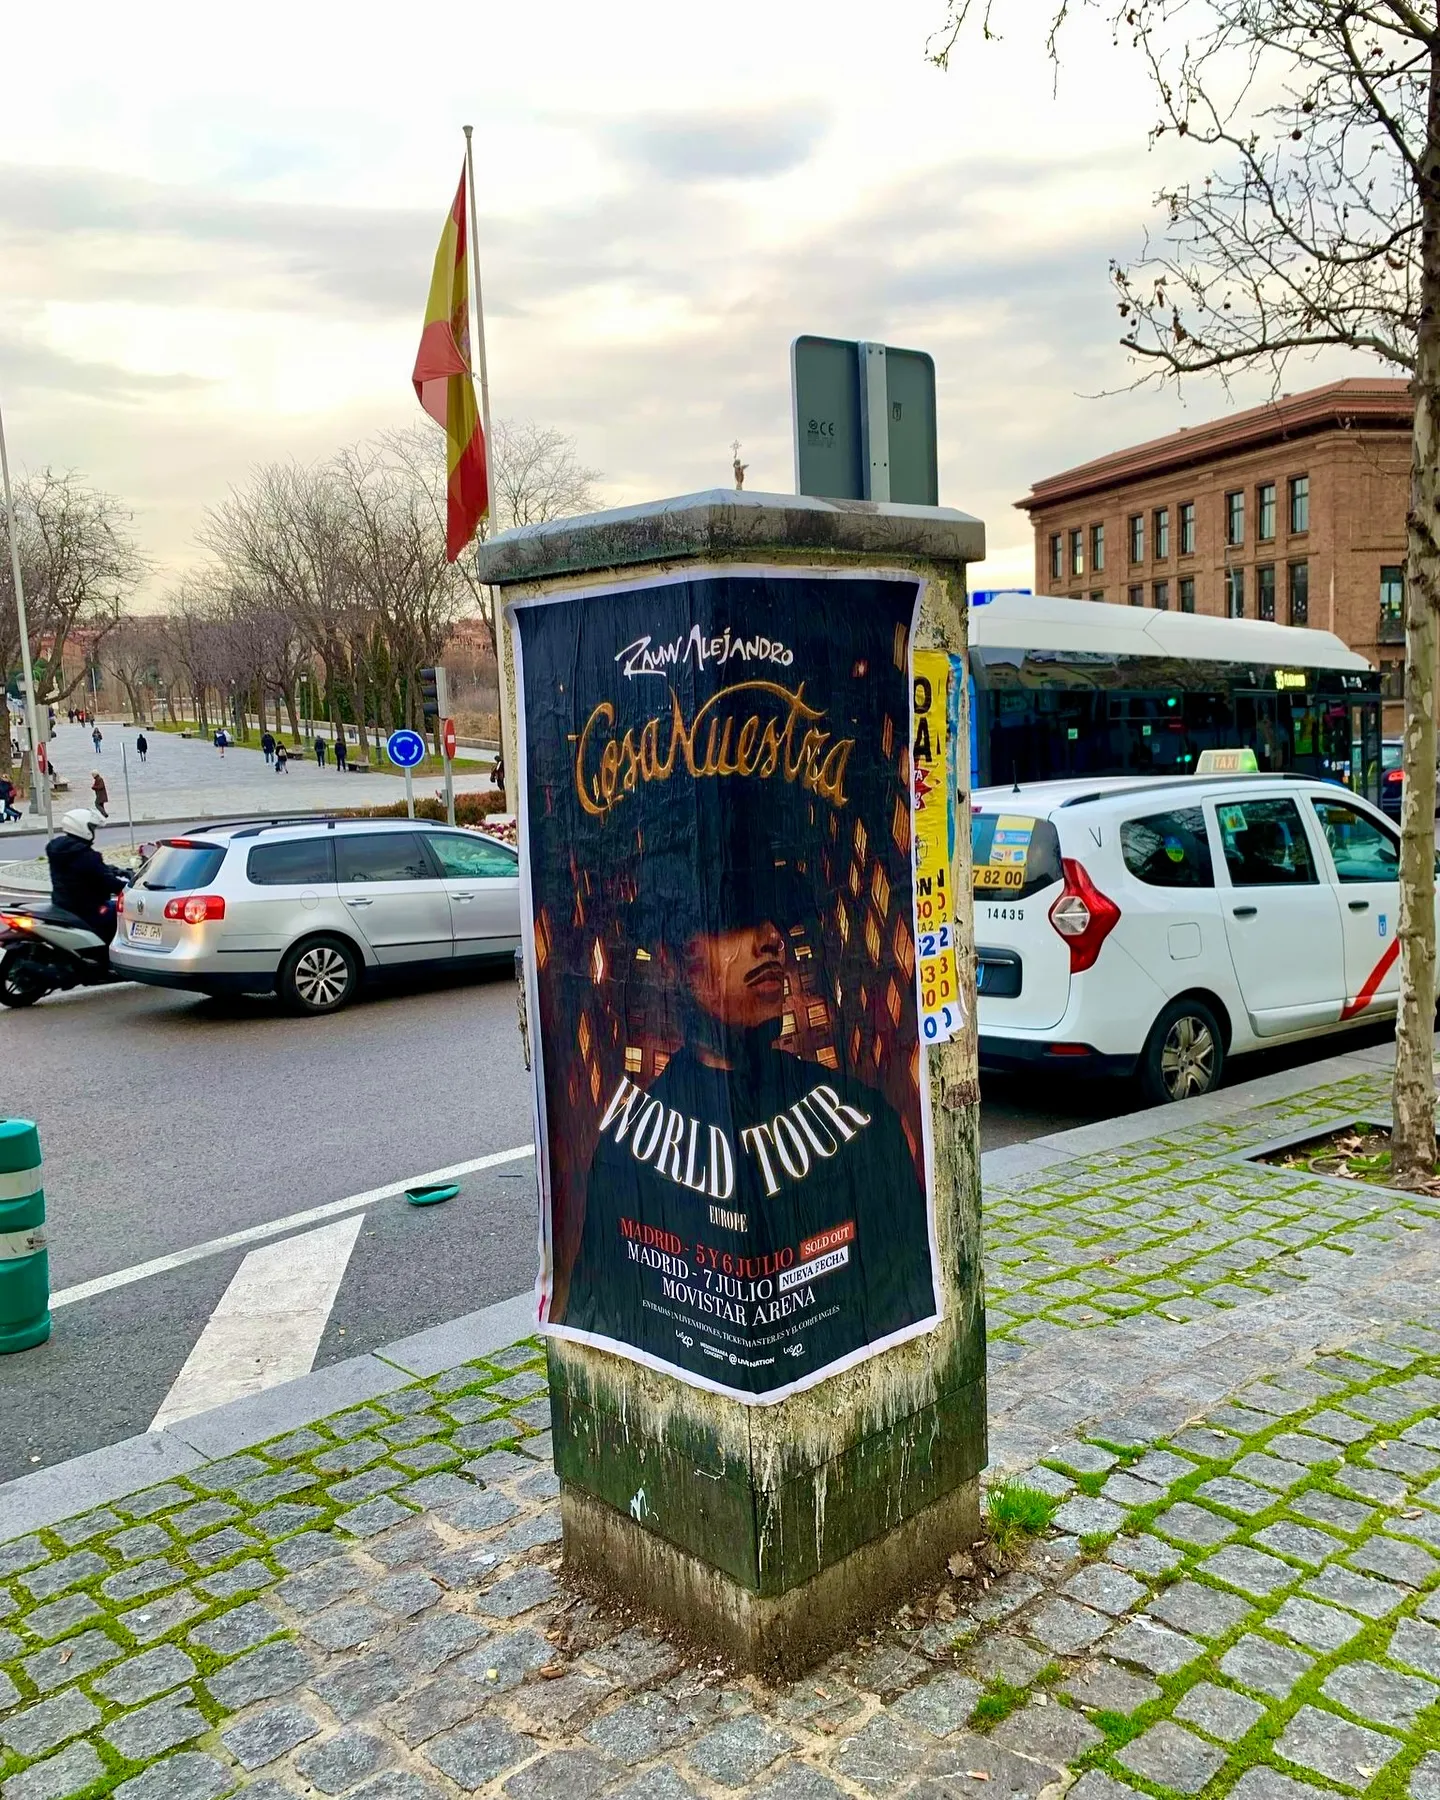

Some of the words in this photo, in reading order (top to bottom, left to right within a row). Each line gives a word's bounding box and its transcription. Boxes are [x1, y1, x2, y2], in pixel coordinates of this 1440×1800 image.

[1214, 754, 1239, 770] TAXI
[983, 869, 1000, 885] 82
[1004, 871, 1023, 886] 00
[987, 907, 1024, 921] 14435
[599, 1075, 734, 1199] WORLD
[741, 1085, 871, 1197] TOUR
[709, 1205, 748, 1233] EUROPE
[620, 1218, 682, 1255] MADRID
[735, 1247, 794, 1279] JULIO
[804, 1234, 829, 1255] SOLD
[829, 1226, 850, 1246] OUT
[627, 1241, 689, 1280] MADRID
[715, 1275, 773, 1303] JULIO
[782, 1264, 813, 1287] NUEVA
[815, 1252, 845, 1274] FECHA
[662, 1276, 747, 1327] MOVISTAR
[752, 1285, 816, 1327] ARENA
